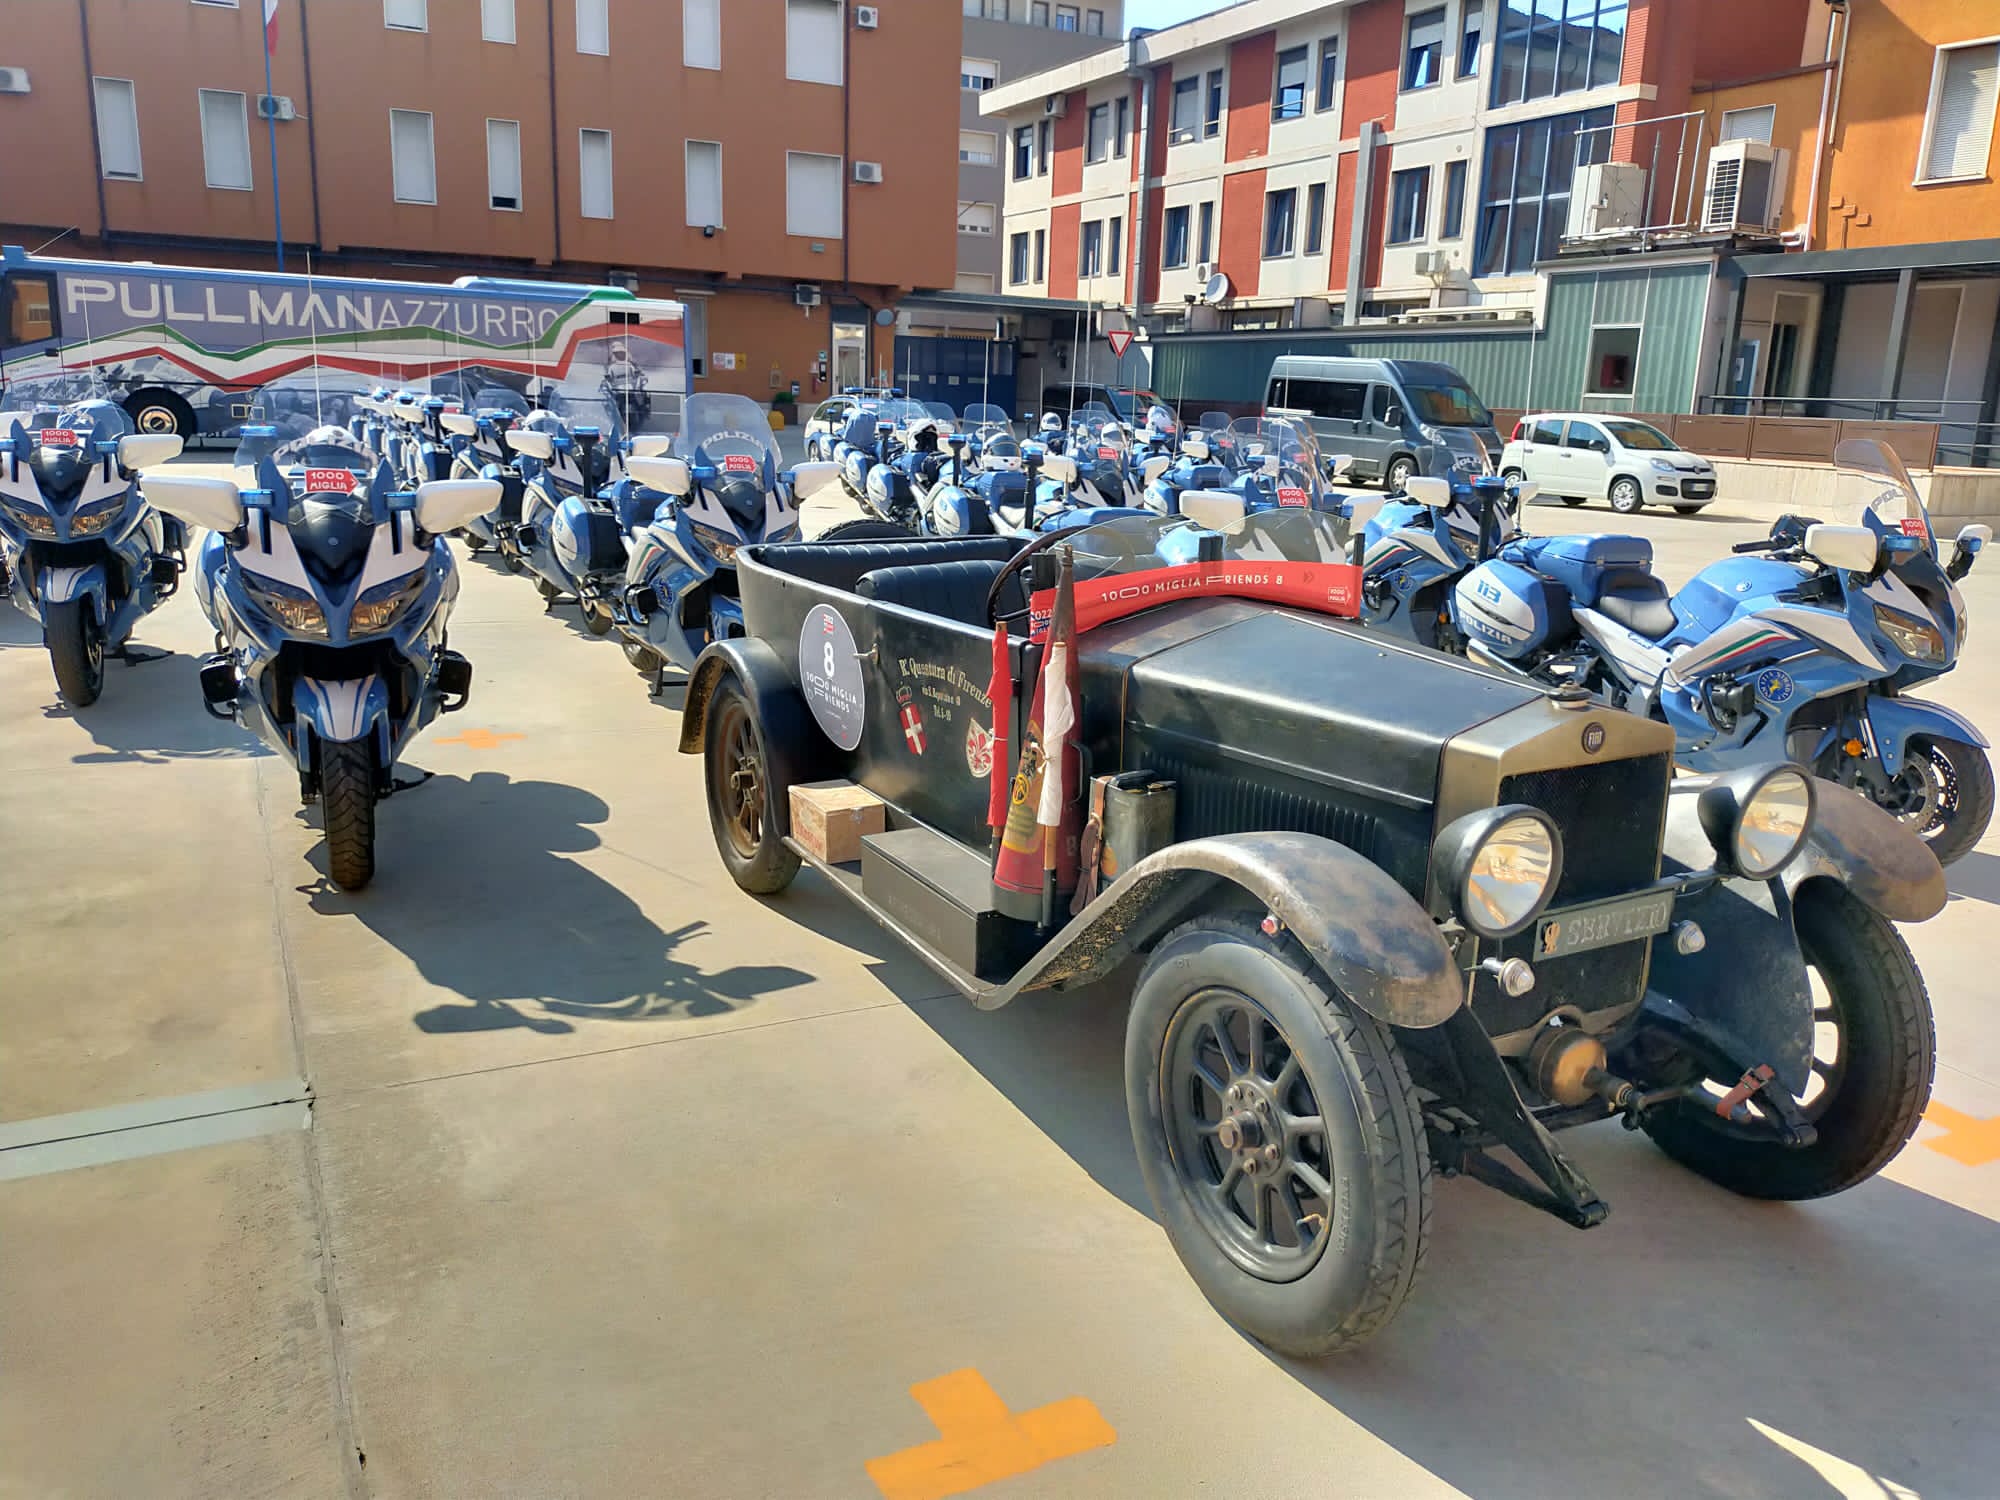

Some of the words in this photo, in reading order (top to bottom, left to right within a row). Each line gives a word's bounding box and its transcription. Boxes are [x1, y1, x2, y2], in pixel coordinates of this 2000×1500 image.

[309, 481, 348, 490] MIGLIA
[311, 471, 345, 480] 1000
[1101, 584, 1150, 603] 1000
[1154, 577, 1201, 593] MIGLIA
[1205, 574, 1269, 586] FRIENDS
[1275, 575, 1283, 585] 8
[1477, 580, 1501, 604] 113
[1460, 610, 1512, 645] POLIZIA
[824, 641, 835, 679] 8
[831, 685, 857, 705] MIGLIA
[958, 671, 992, 708] Firenze
